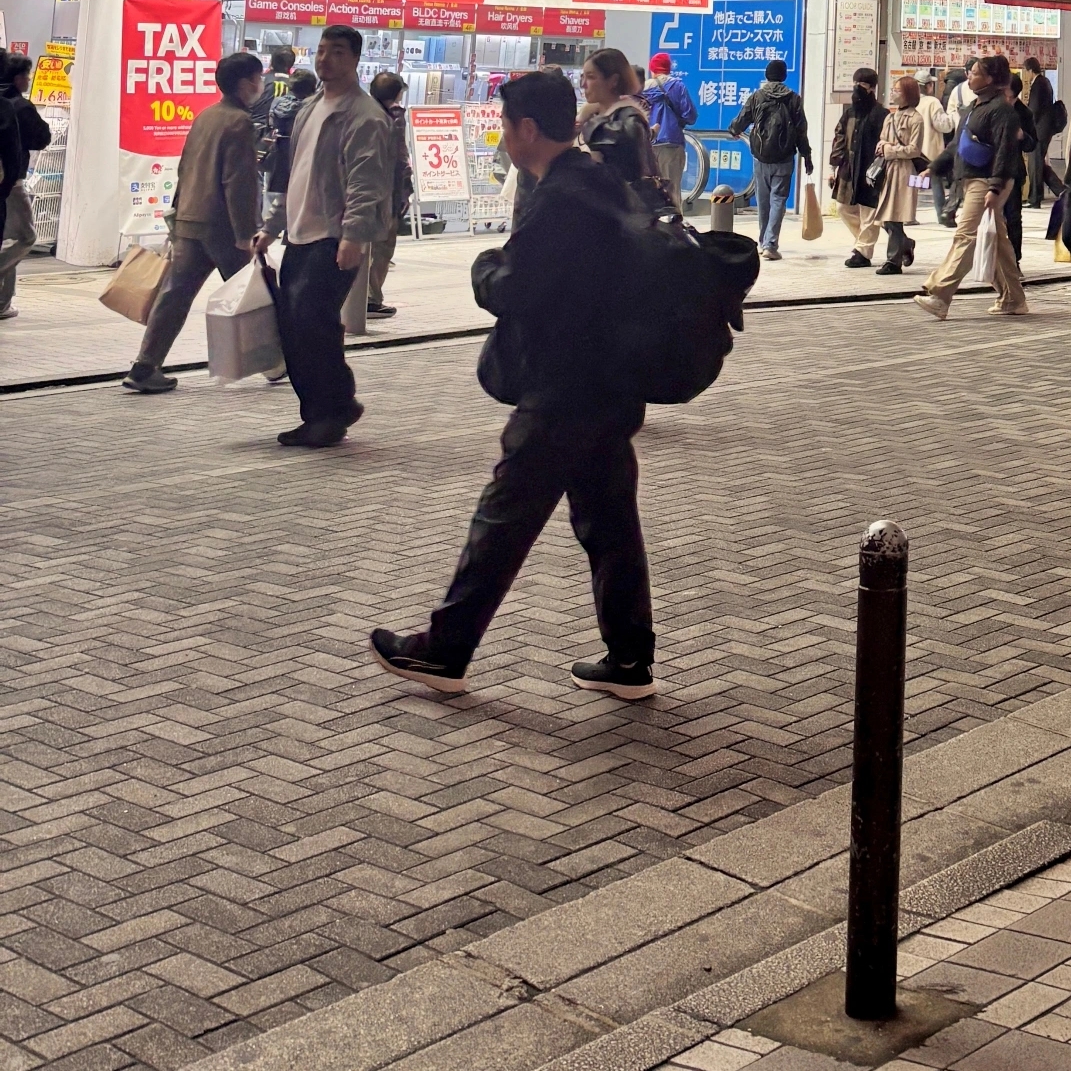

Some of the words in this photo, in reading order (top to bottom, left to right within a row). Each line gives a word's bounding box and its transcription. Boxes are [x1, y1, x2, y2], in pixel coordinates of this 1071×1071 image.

[280, 0, 325, 12] Consoles
[329, 3, 359, 14] Action
[361, 5, 402, 16] Cameras
[412, 8, 438, 18] BLDC
[440, 10, 468, 21] Dryers
[488, 12, 504, 21] Hair
[506, 14, 533, 25] Dryers
[560, 16, 590, 26] Shavers
[714, 11, 783, 25] 他店でご購入の
[138, 23, 207, 57] TAX
[711, 29, 784, 42] パソコン・スマホ
[126, 60, 216, 94] FREE
[151, 100, 193, 121] 10%
